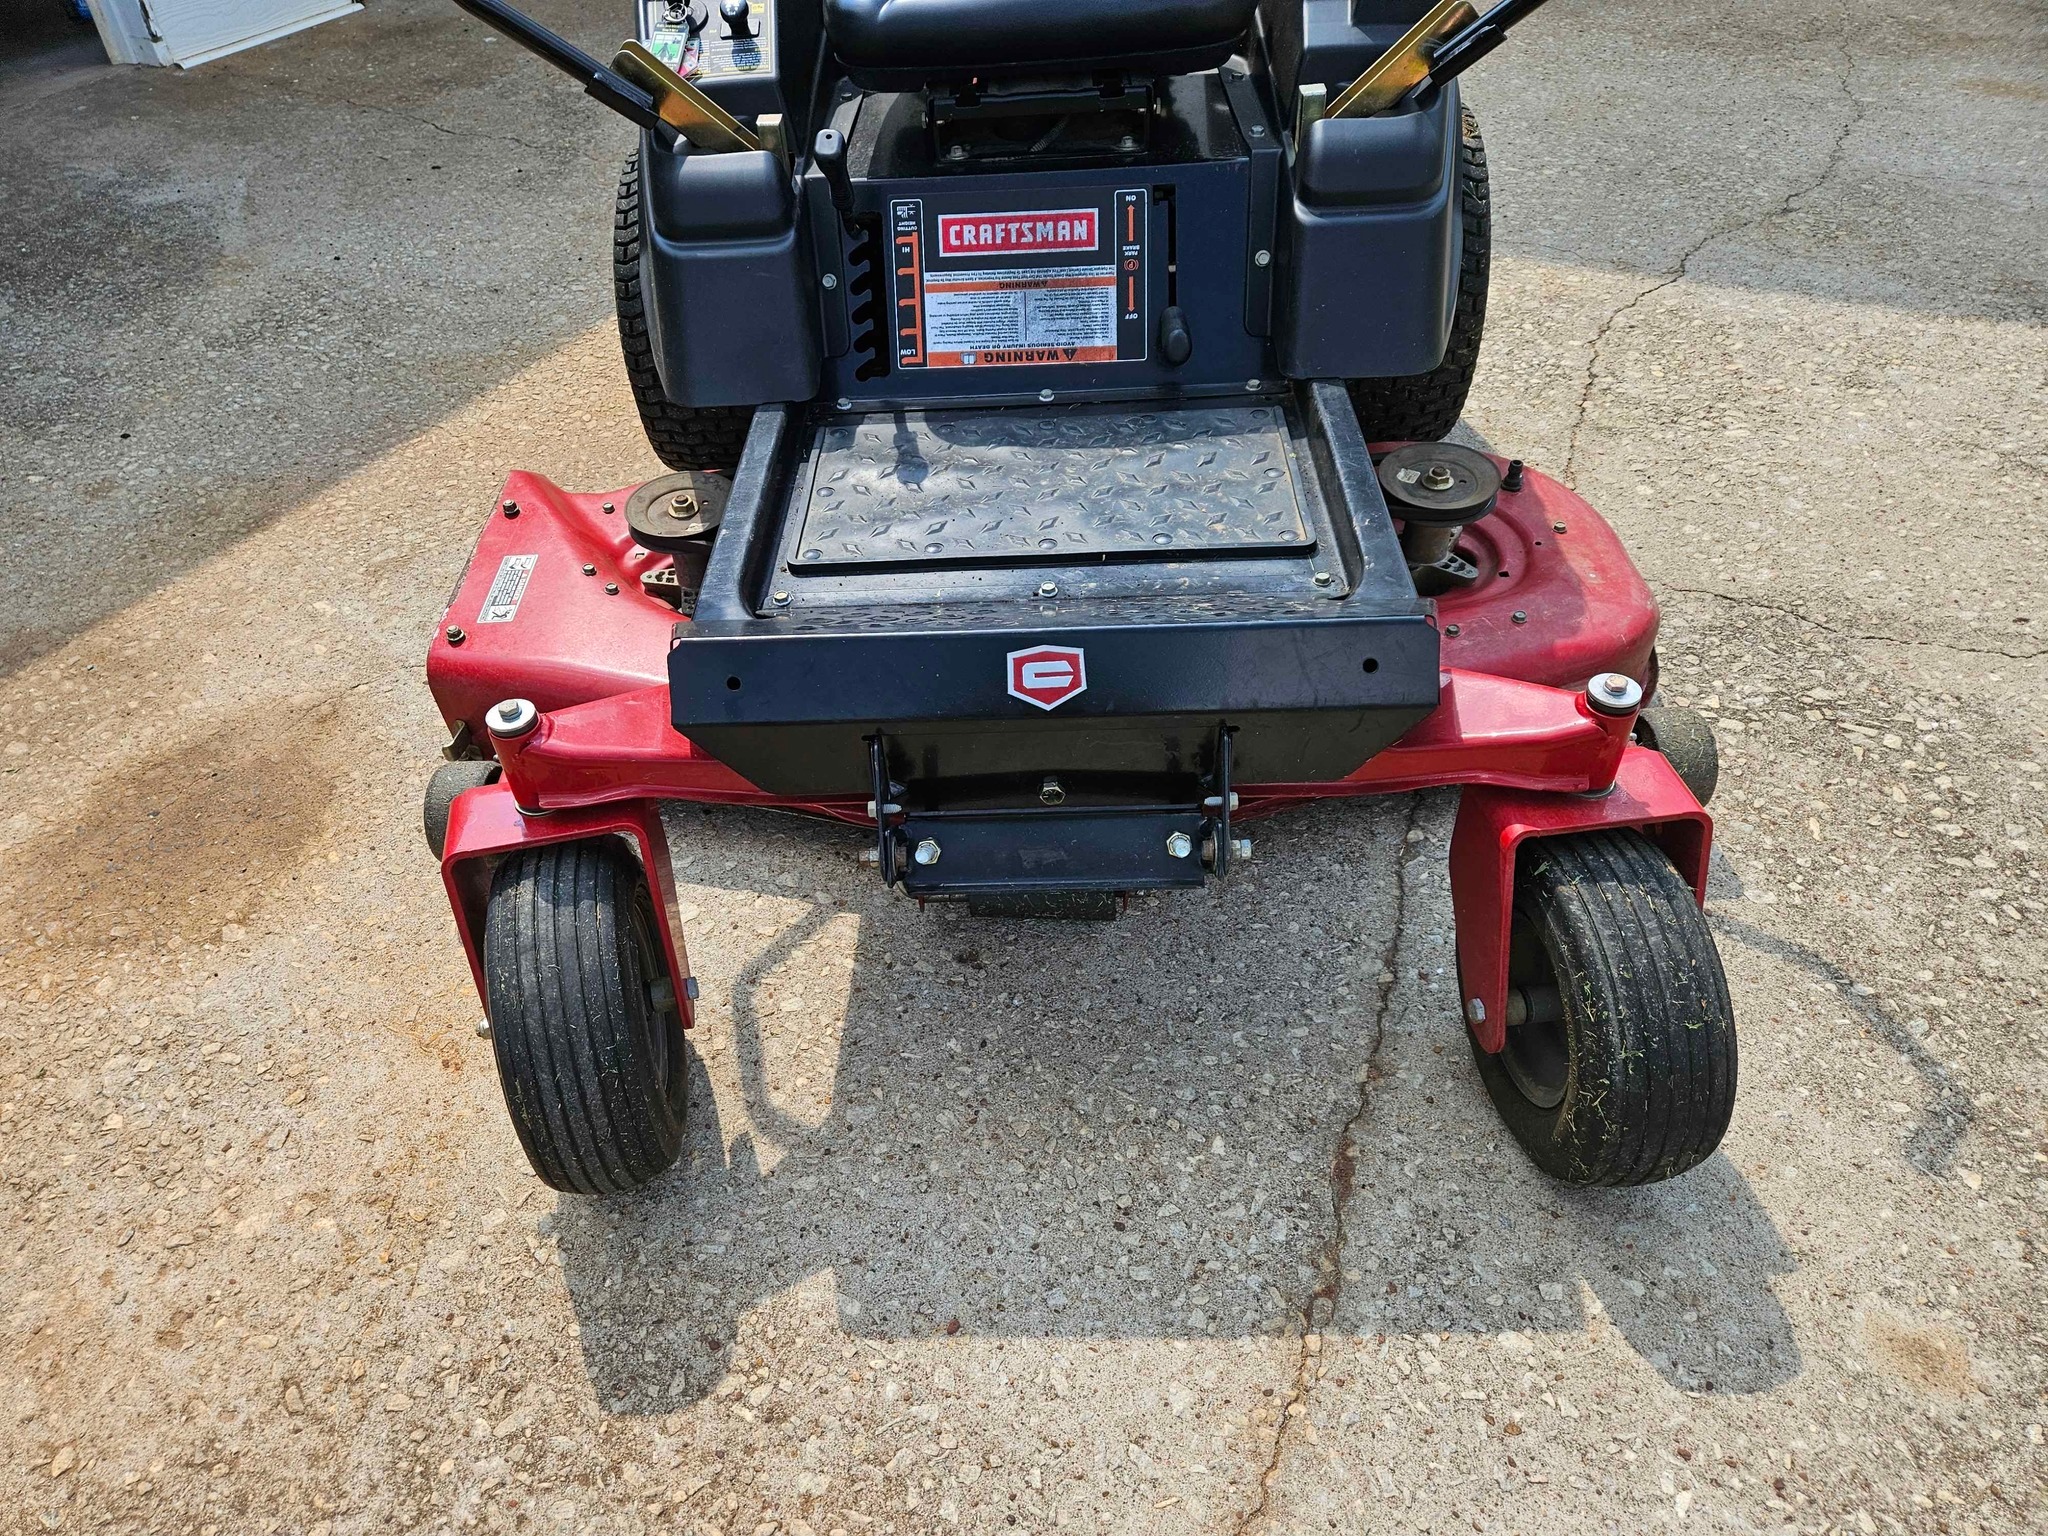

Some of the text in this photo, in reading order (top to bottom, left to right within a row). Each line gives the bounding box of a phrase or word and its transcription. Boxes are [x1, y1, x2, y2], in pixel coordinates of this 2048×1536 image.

[1125, 194, 1137, 202] ON
[949, 219, 1089, 246] CRAFTSMAN
[999, 281, 1041, 290] WARNING
[900, 348, 916, 356] LOW
[983, 350, 1059, 363] WARNING
